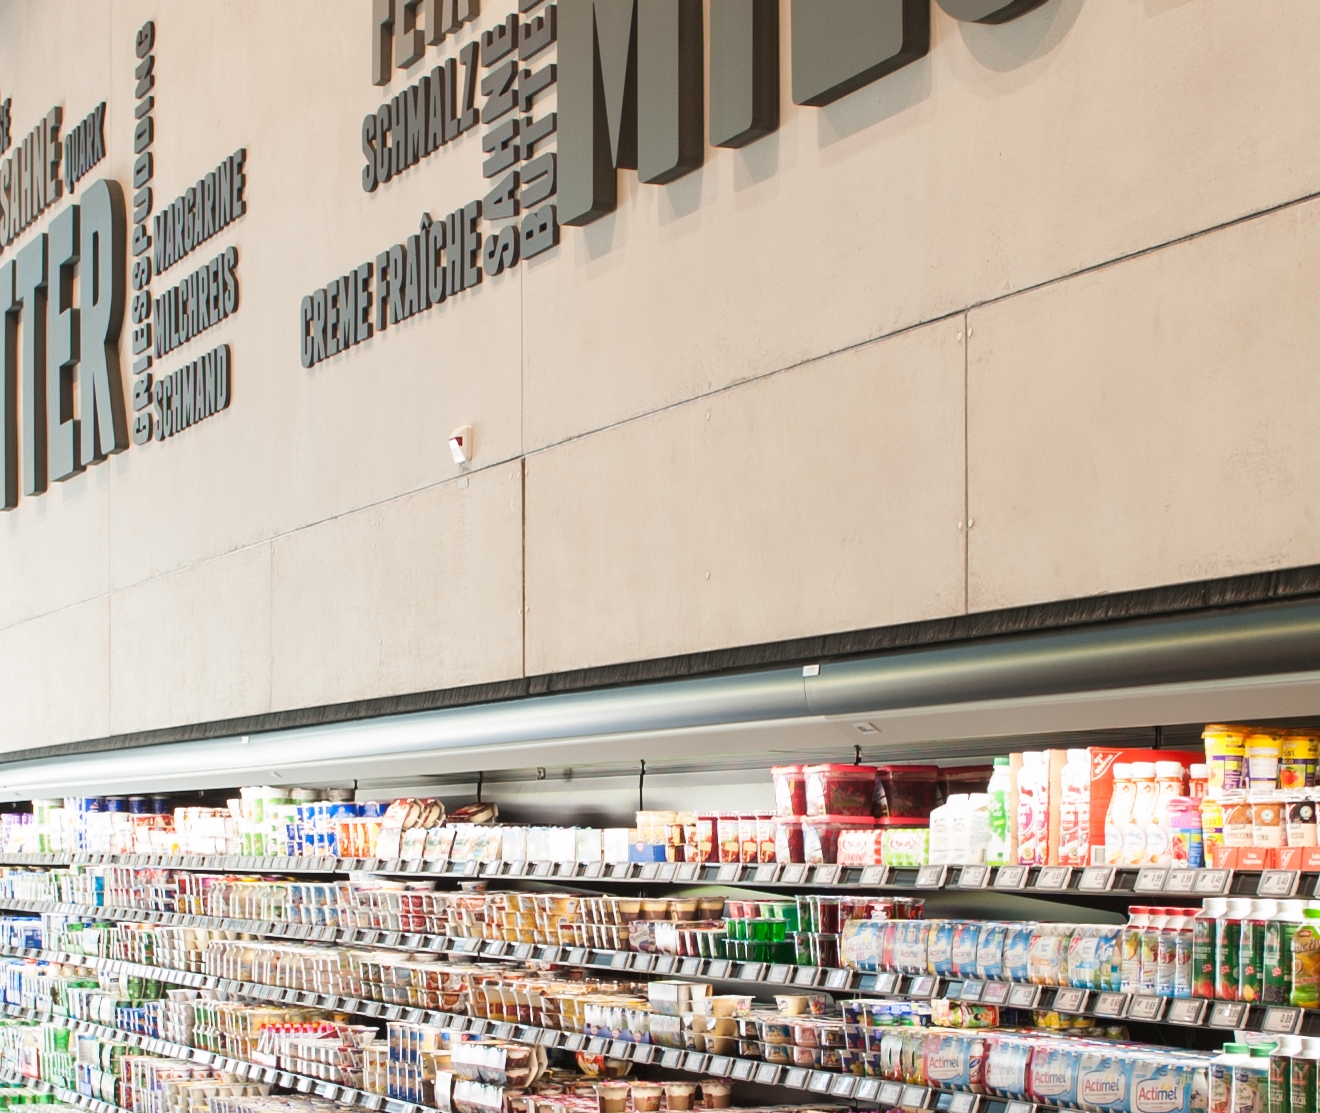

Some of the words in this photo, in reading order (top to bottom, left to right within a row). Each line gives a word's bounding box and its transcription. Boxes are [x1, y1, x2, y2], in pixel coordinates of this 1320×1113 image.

[65, 102, 106, 194] QUARK
[362, 41, 480, 193] SCHMALZ
[481, 14, 519, 276] SAHNE
[519, 0, 560, 261] BUTTE
[133, 20, 155, 446] GRIESSPUDDING
[153, 147, 247, 276] MARGARINE
[153, 245, 239, 359] MILCHREIS
[300, 261, 374, 369] CREME
[375, 199, 483, 332] FRAÎCHE
[153, 343, 232, 442] SCHMAND
[929, 1056, 959, 1069] Actimel
[1034, 1070, 1067, 1084] Actimel
[1084, 1078, 1120, 1092] Actimel
[1138, 1086, 1177, 1101] Actimel
